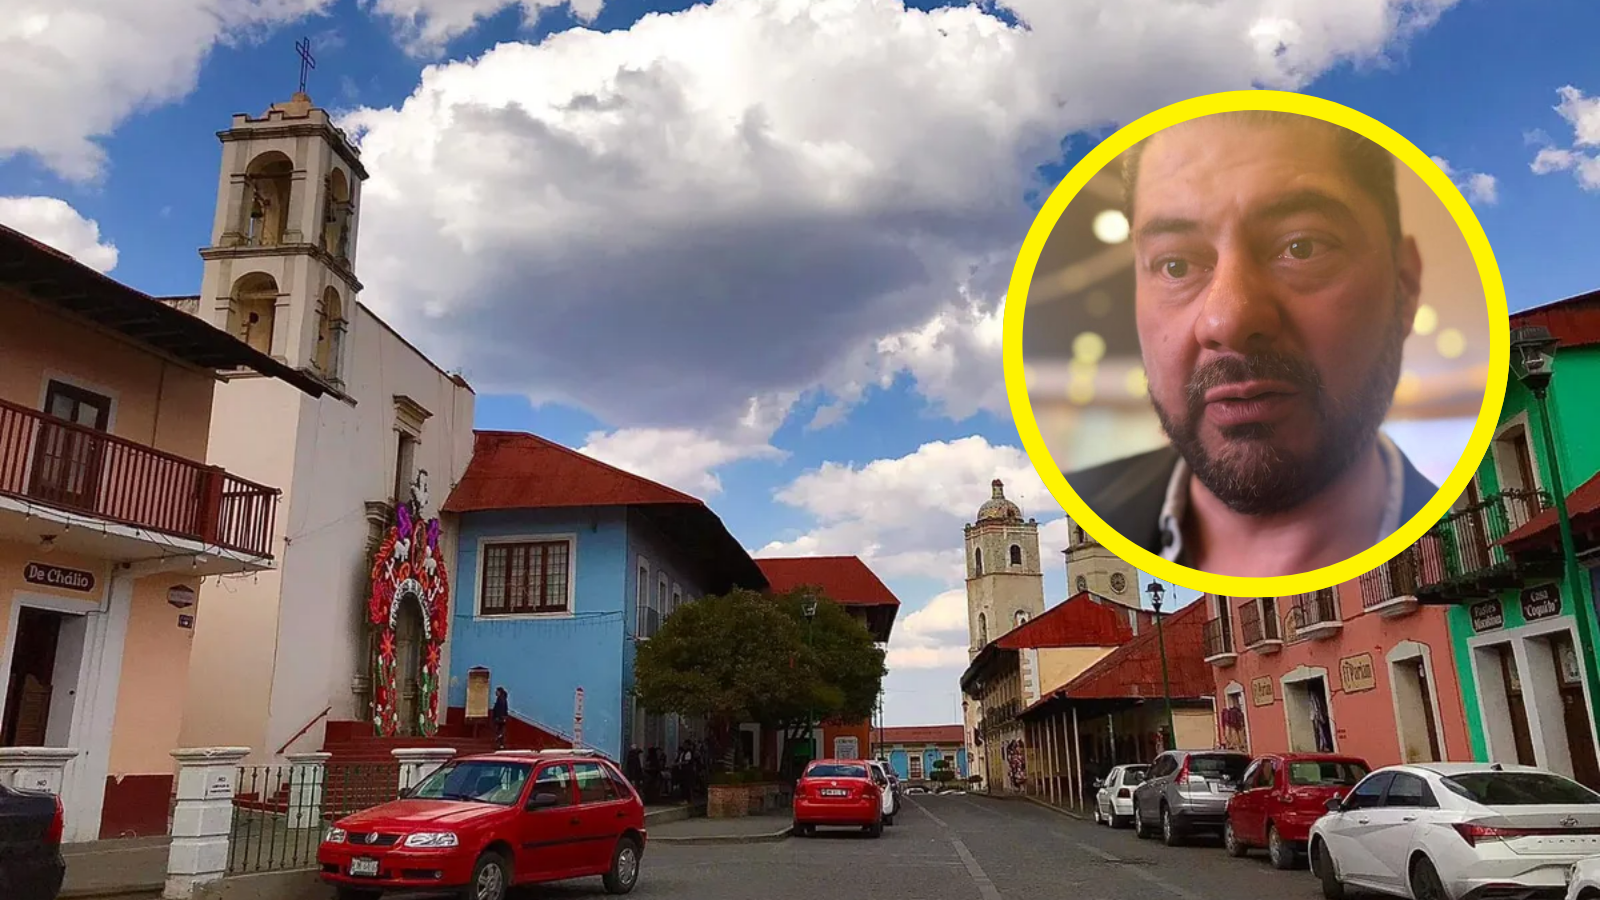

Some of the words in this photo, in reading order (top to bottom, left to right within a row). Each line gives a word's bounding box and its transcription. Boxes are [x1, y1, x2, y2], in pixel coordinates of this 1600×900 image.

[28, 565, 45, 580] De
[47, 569, 89, 587] Chálio
[1530, 591, 1548, 602] Casa
